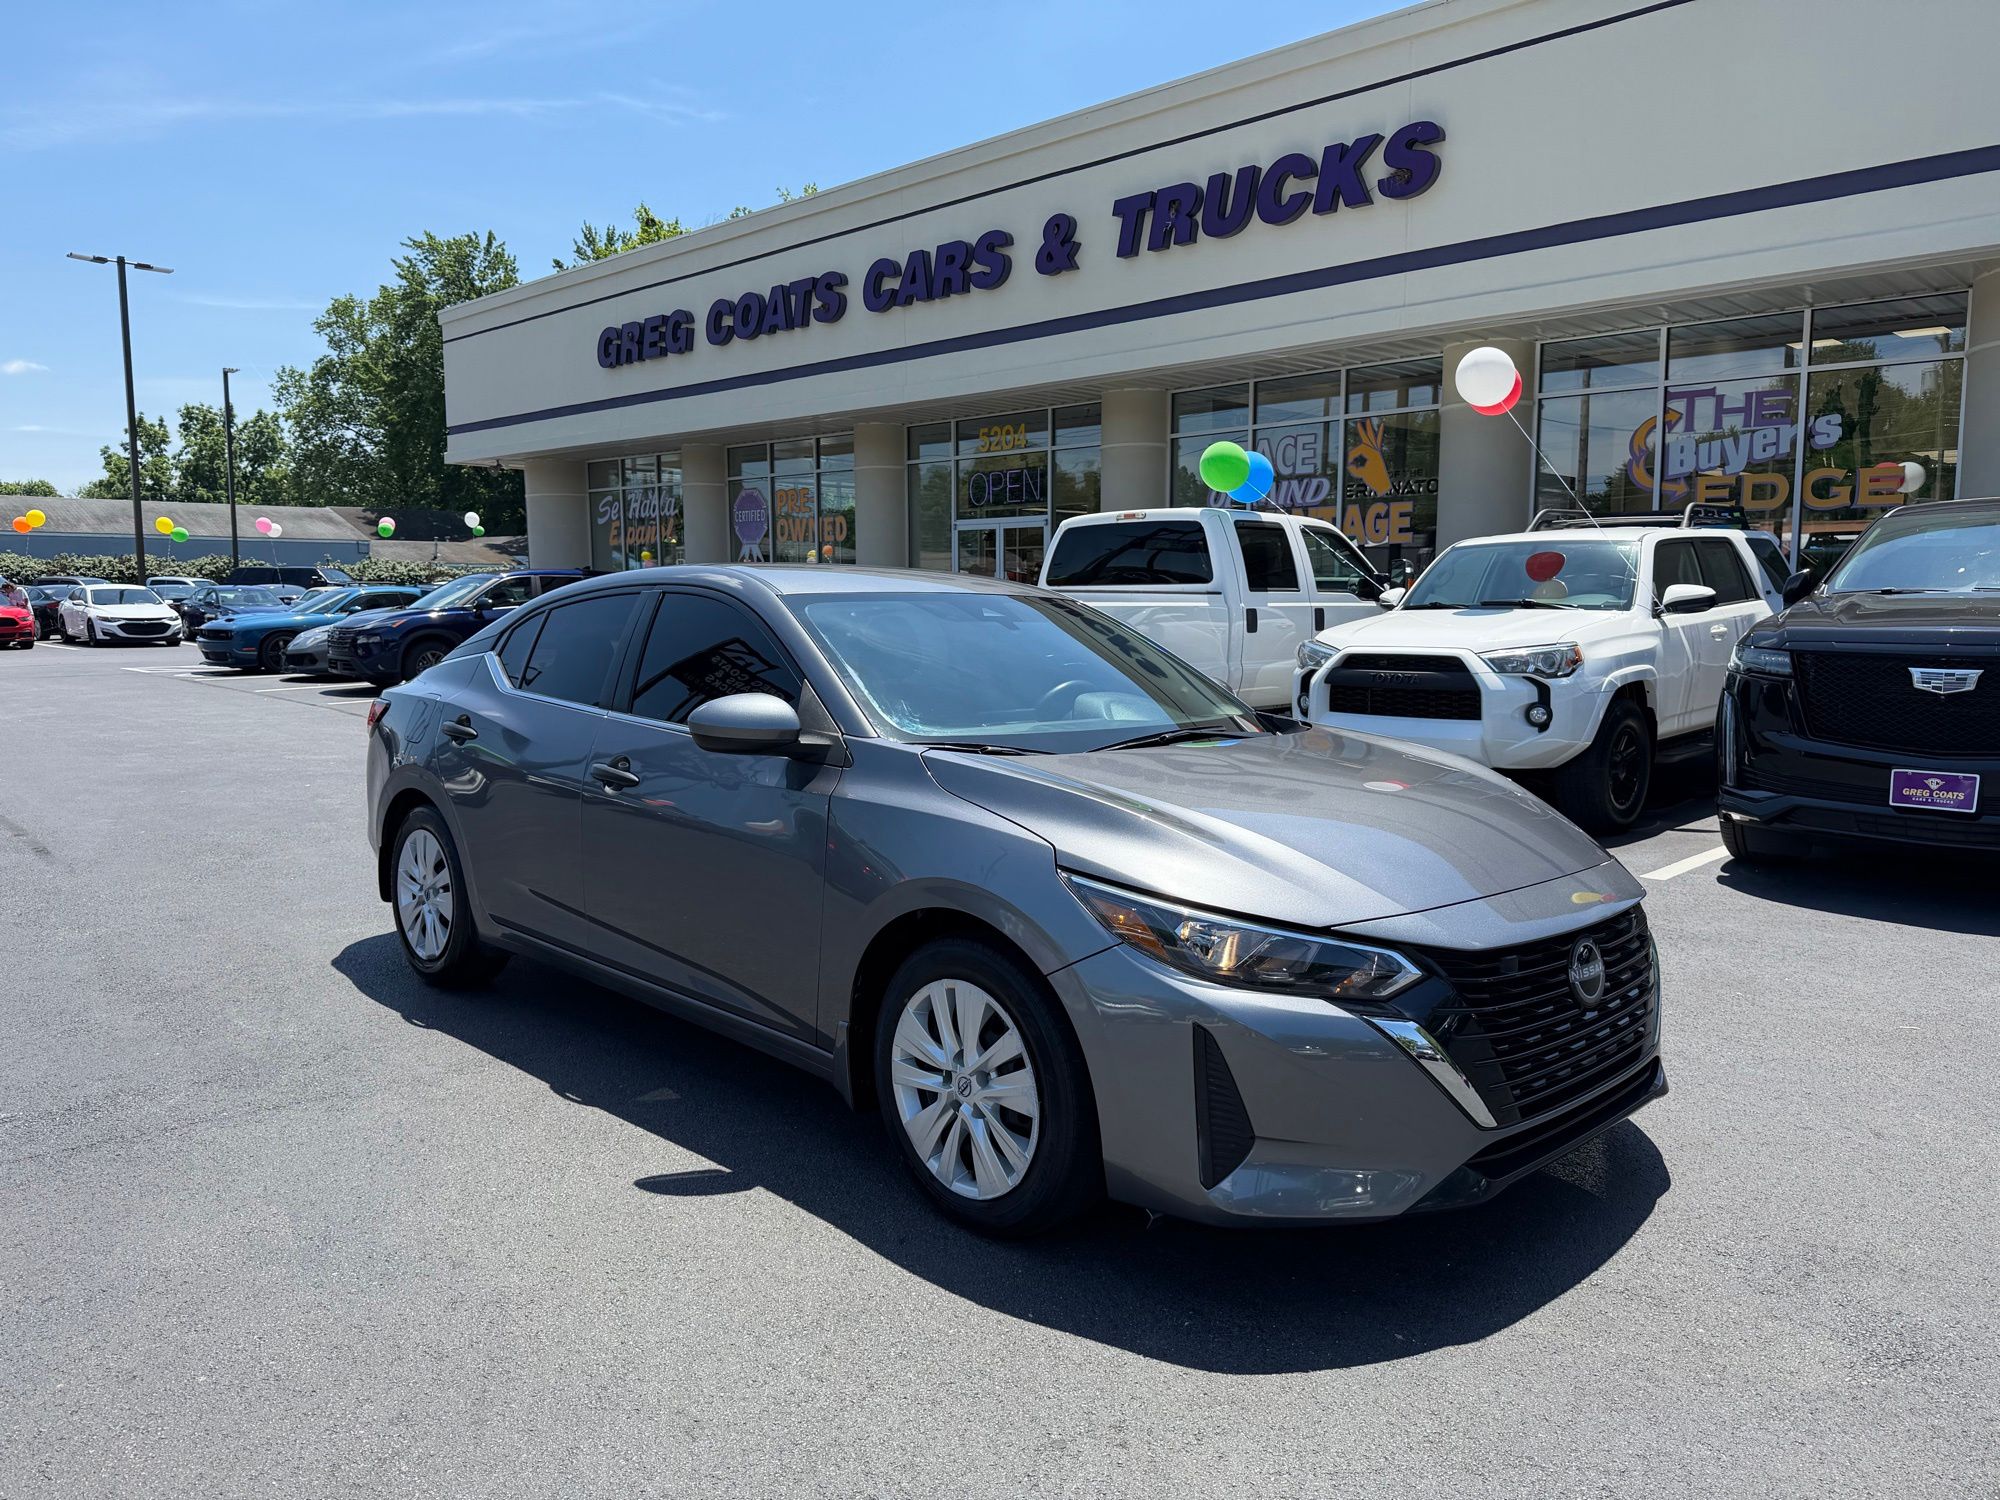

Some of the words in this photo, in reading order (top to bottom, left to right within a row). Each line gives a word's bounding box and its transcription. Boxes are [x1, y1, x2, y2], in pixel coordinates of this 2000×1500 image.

[597, 308, 695, 369] GREG
[705, 270, 849, 346] COATS
[863, 228, 1014, 313] CARS
[1035, 212, 1082, 276] &
[1112, 120, 1446, 259] TRUCKS
[1664, 387, 1793, 433] THE
[978, 423, 1028, 452] 5204
[969, 467, 1041, 506] OPEN
[1695, 464, 1905, 511] EDGE
[597, 495, 619, 525] Se
[735, 509, 766, 522] CERTIFIED
[1902, 787, 1930, 797] GREG
[1932, 790, 1965, 800] COATS
